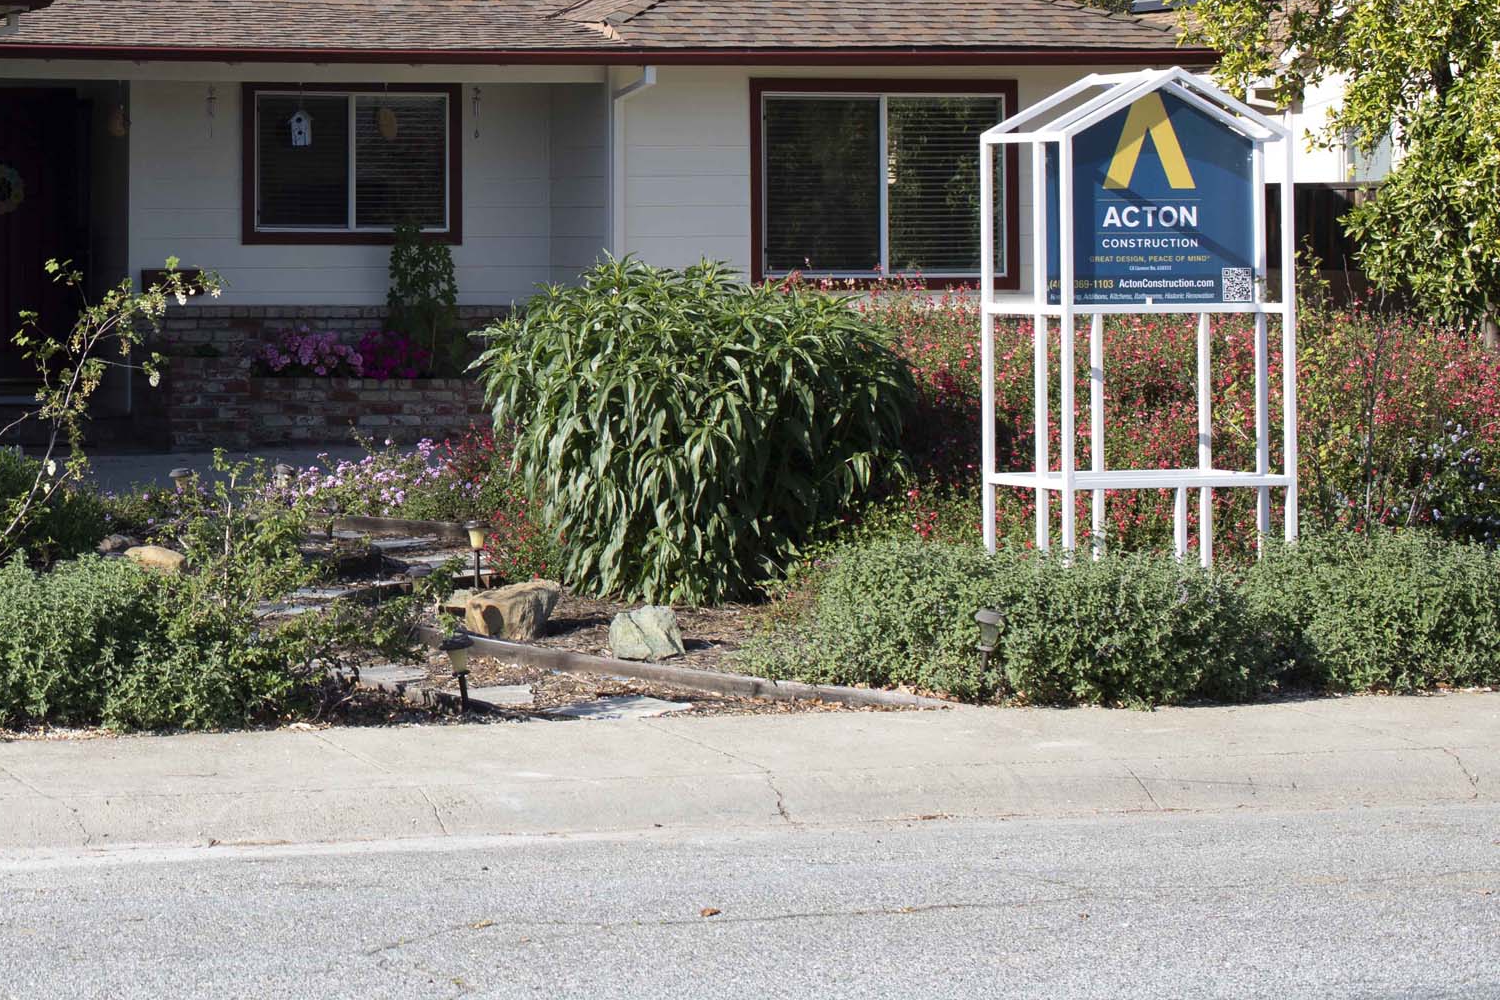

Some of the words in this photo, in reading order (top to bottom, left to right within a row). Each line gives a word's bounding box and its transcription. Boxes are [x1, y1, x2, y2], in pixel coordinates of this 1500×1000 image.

[1102, 205, 1198, 228] ACTON
[1101, 238, 1199, 248] CONSTRUCTION
[1089, 255, 1114, 263] GREAT
[1115, 255, 1147, 264] DESIGN,
[1148, 255, 1173, 263] PEACE
[1175, 255, 1185, 263] OF
[1118, 278, 1215, 288] ActonConstruction.com
